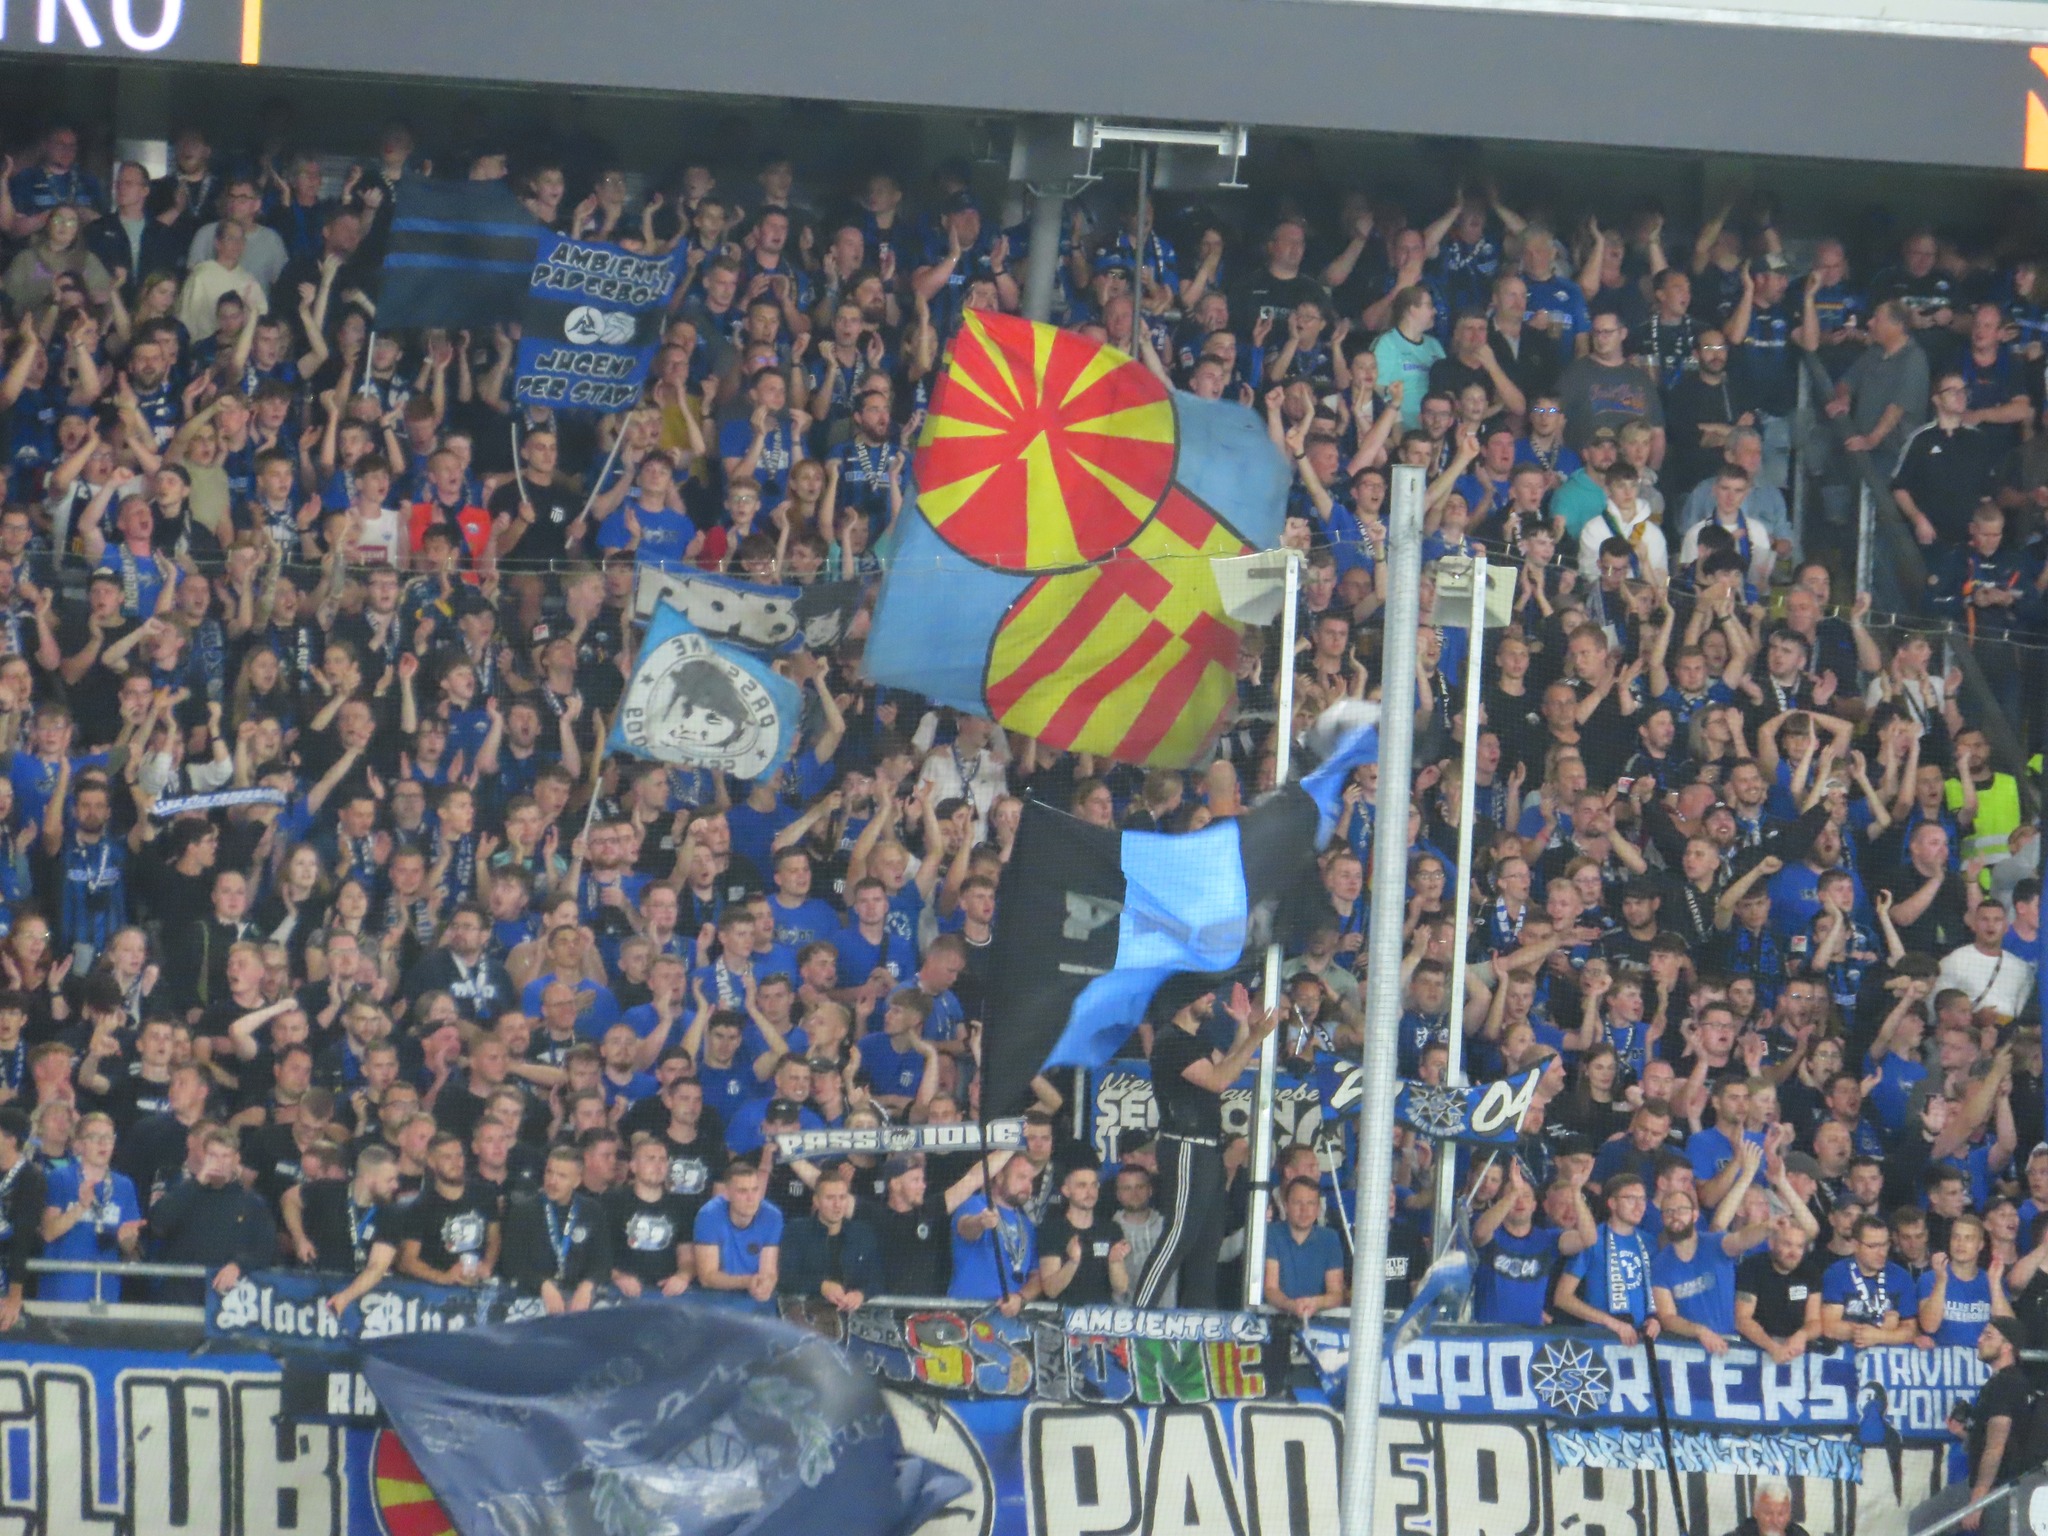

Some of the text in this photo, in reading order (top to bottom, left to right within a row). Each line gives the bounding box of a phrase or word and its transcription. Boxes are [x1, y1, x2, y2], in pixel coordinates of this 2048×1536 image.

[1471, 1068, 1541, 1133] 04
[216, 1276, 340, 1338] Black
[1067, 1307, 1222, 1339] AMBIENTE
